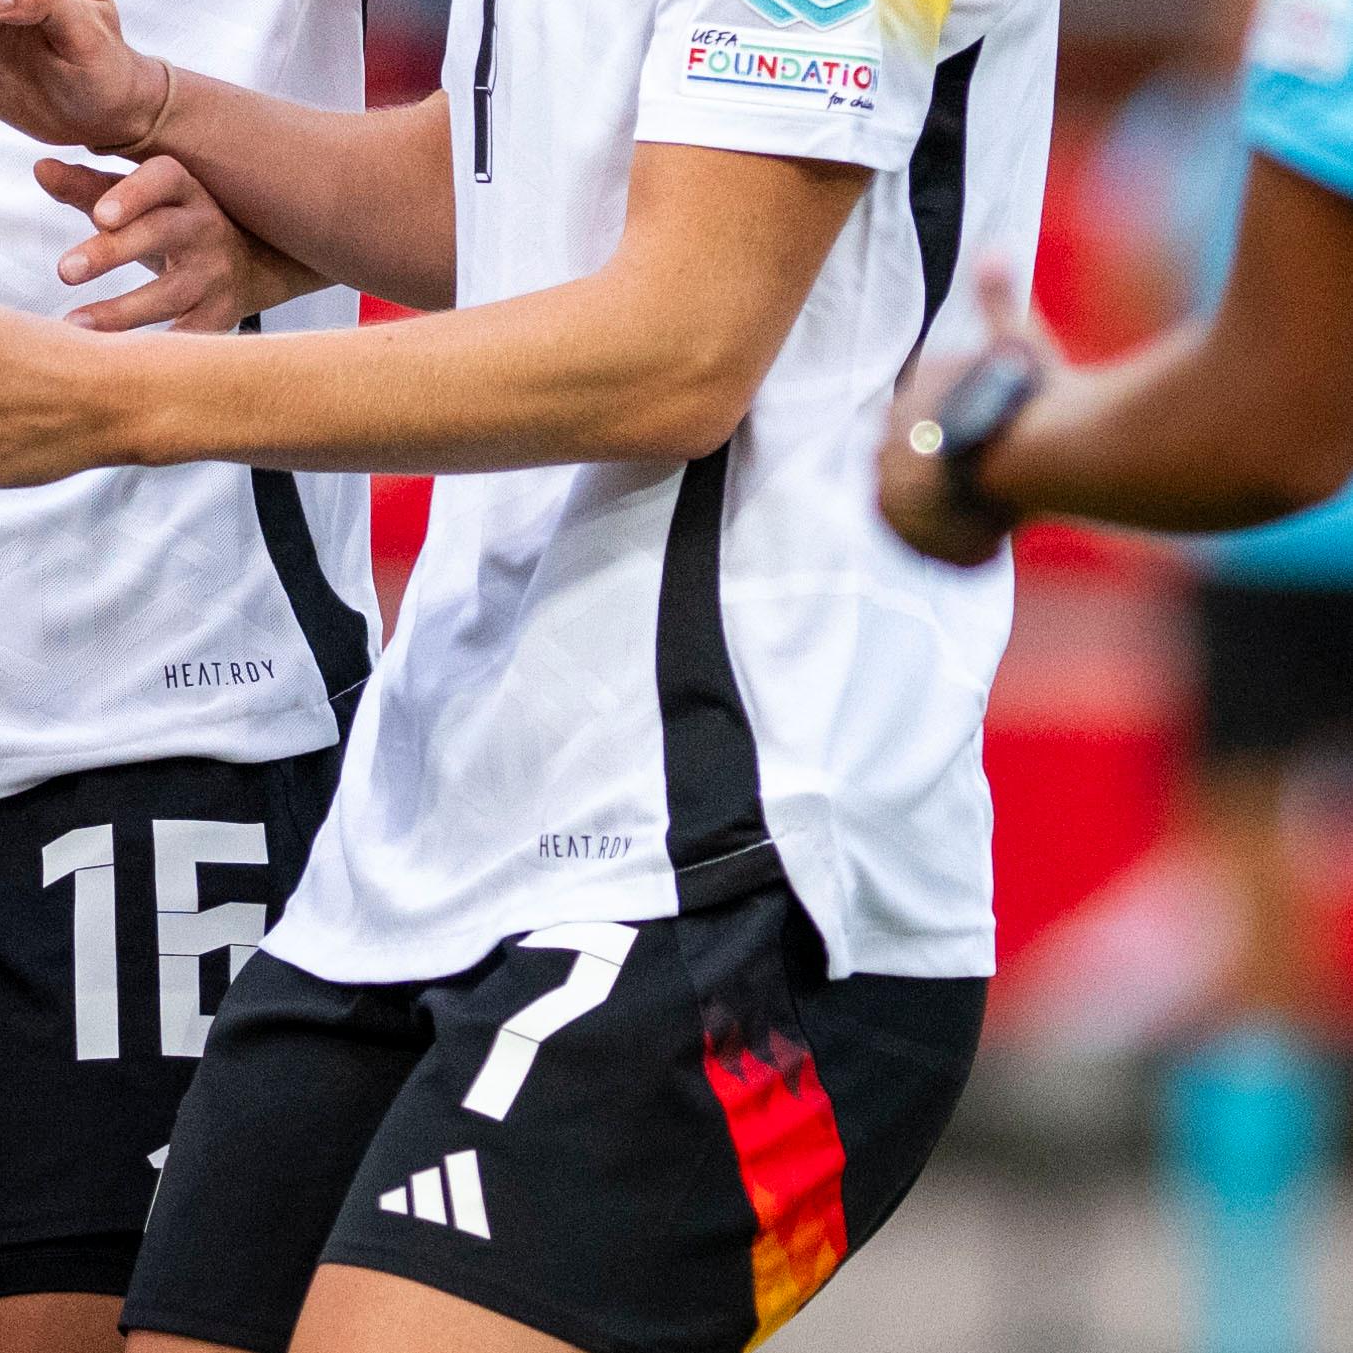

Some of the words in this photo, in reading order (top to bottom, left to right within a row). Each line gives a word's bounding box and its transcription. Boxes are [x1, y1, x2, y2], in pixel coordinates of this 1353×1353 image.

[691, 29, 738, 47] UEFA
[164, 659, 274, 688] HEAT.RDY
[539, 834, 632, 860] HEAT.RDY
[461, 921, 639, 1122] 7
